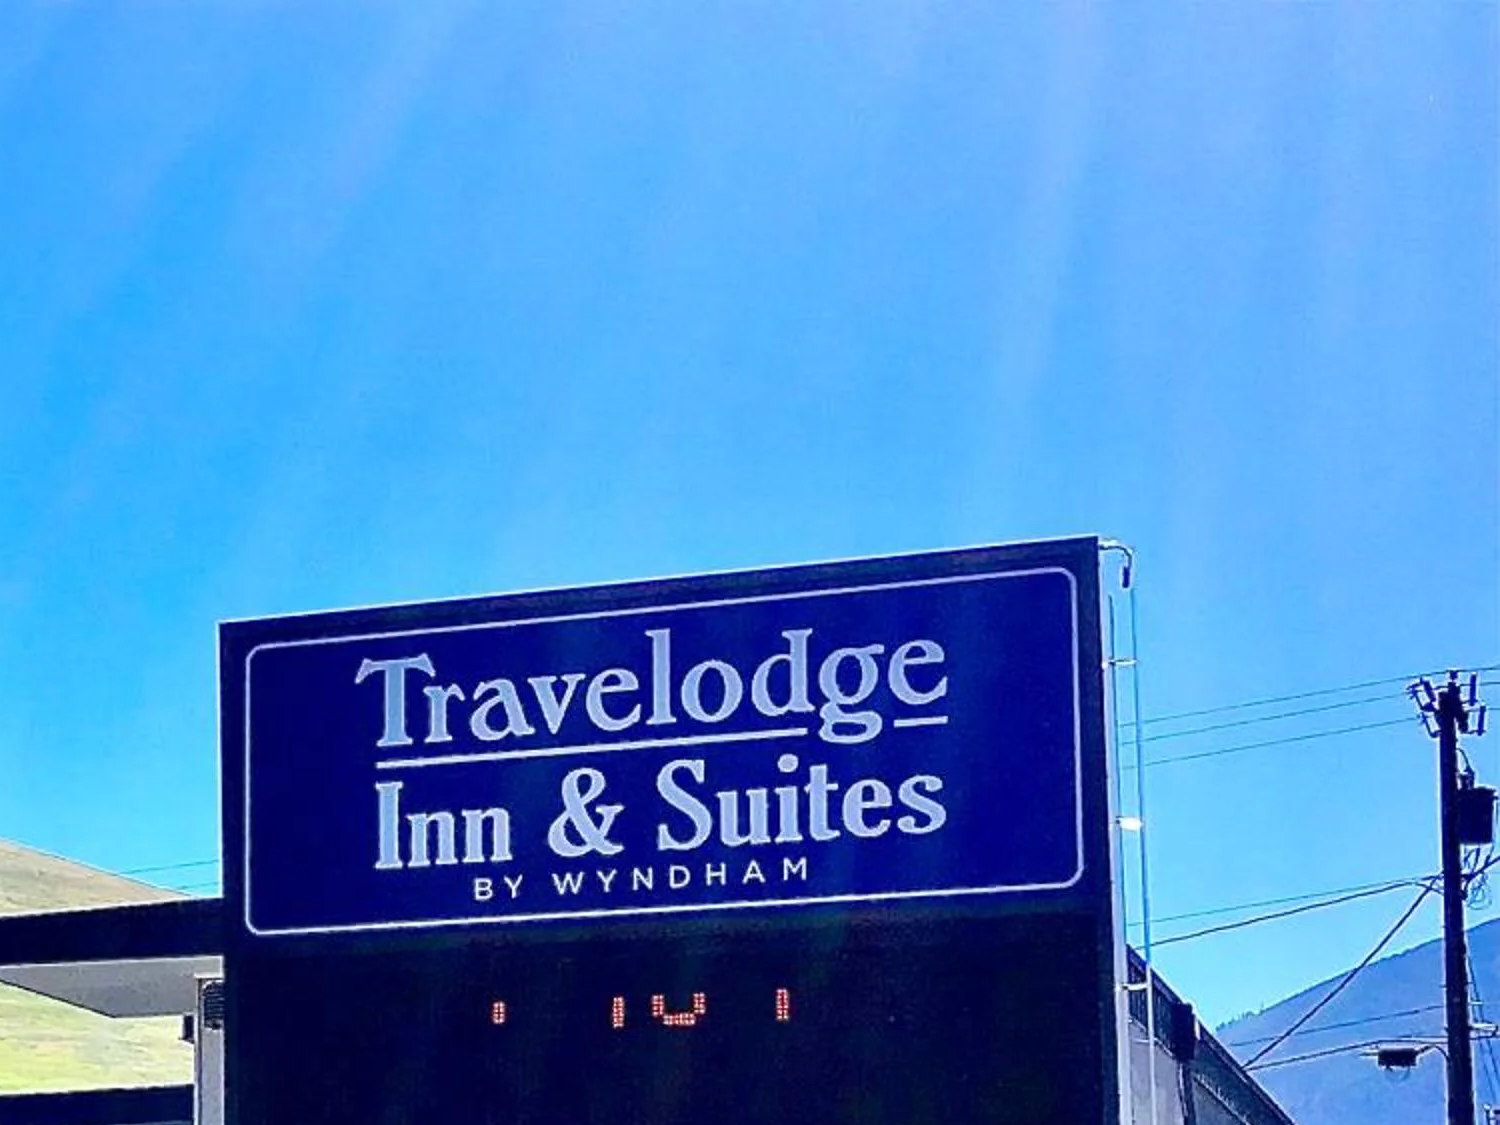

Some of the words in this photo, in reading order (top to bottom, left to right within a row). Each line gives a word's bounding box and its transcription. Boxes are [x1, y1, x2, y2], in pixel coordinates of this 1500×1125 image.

[354, 627, 949, 748] Travelodge
[373, 780, 513, 870] Inn
[547, 767, 625, 858] &
[655, 753, 948, 851] Suites
[472, 873, 524, 902] BY
[550, 856, 808, 897] WYNDHAM
